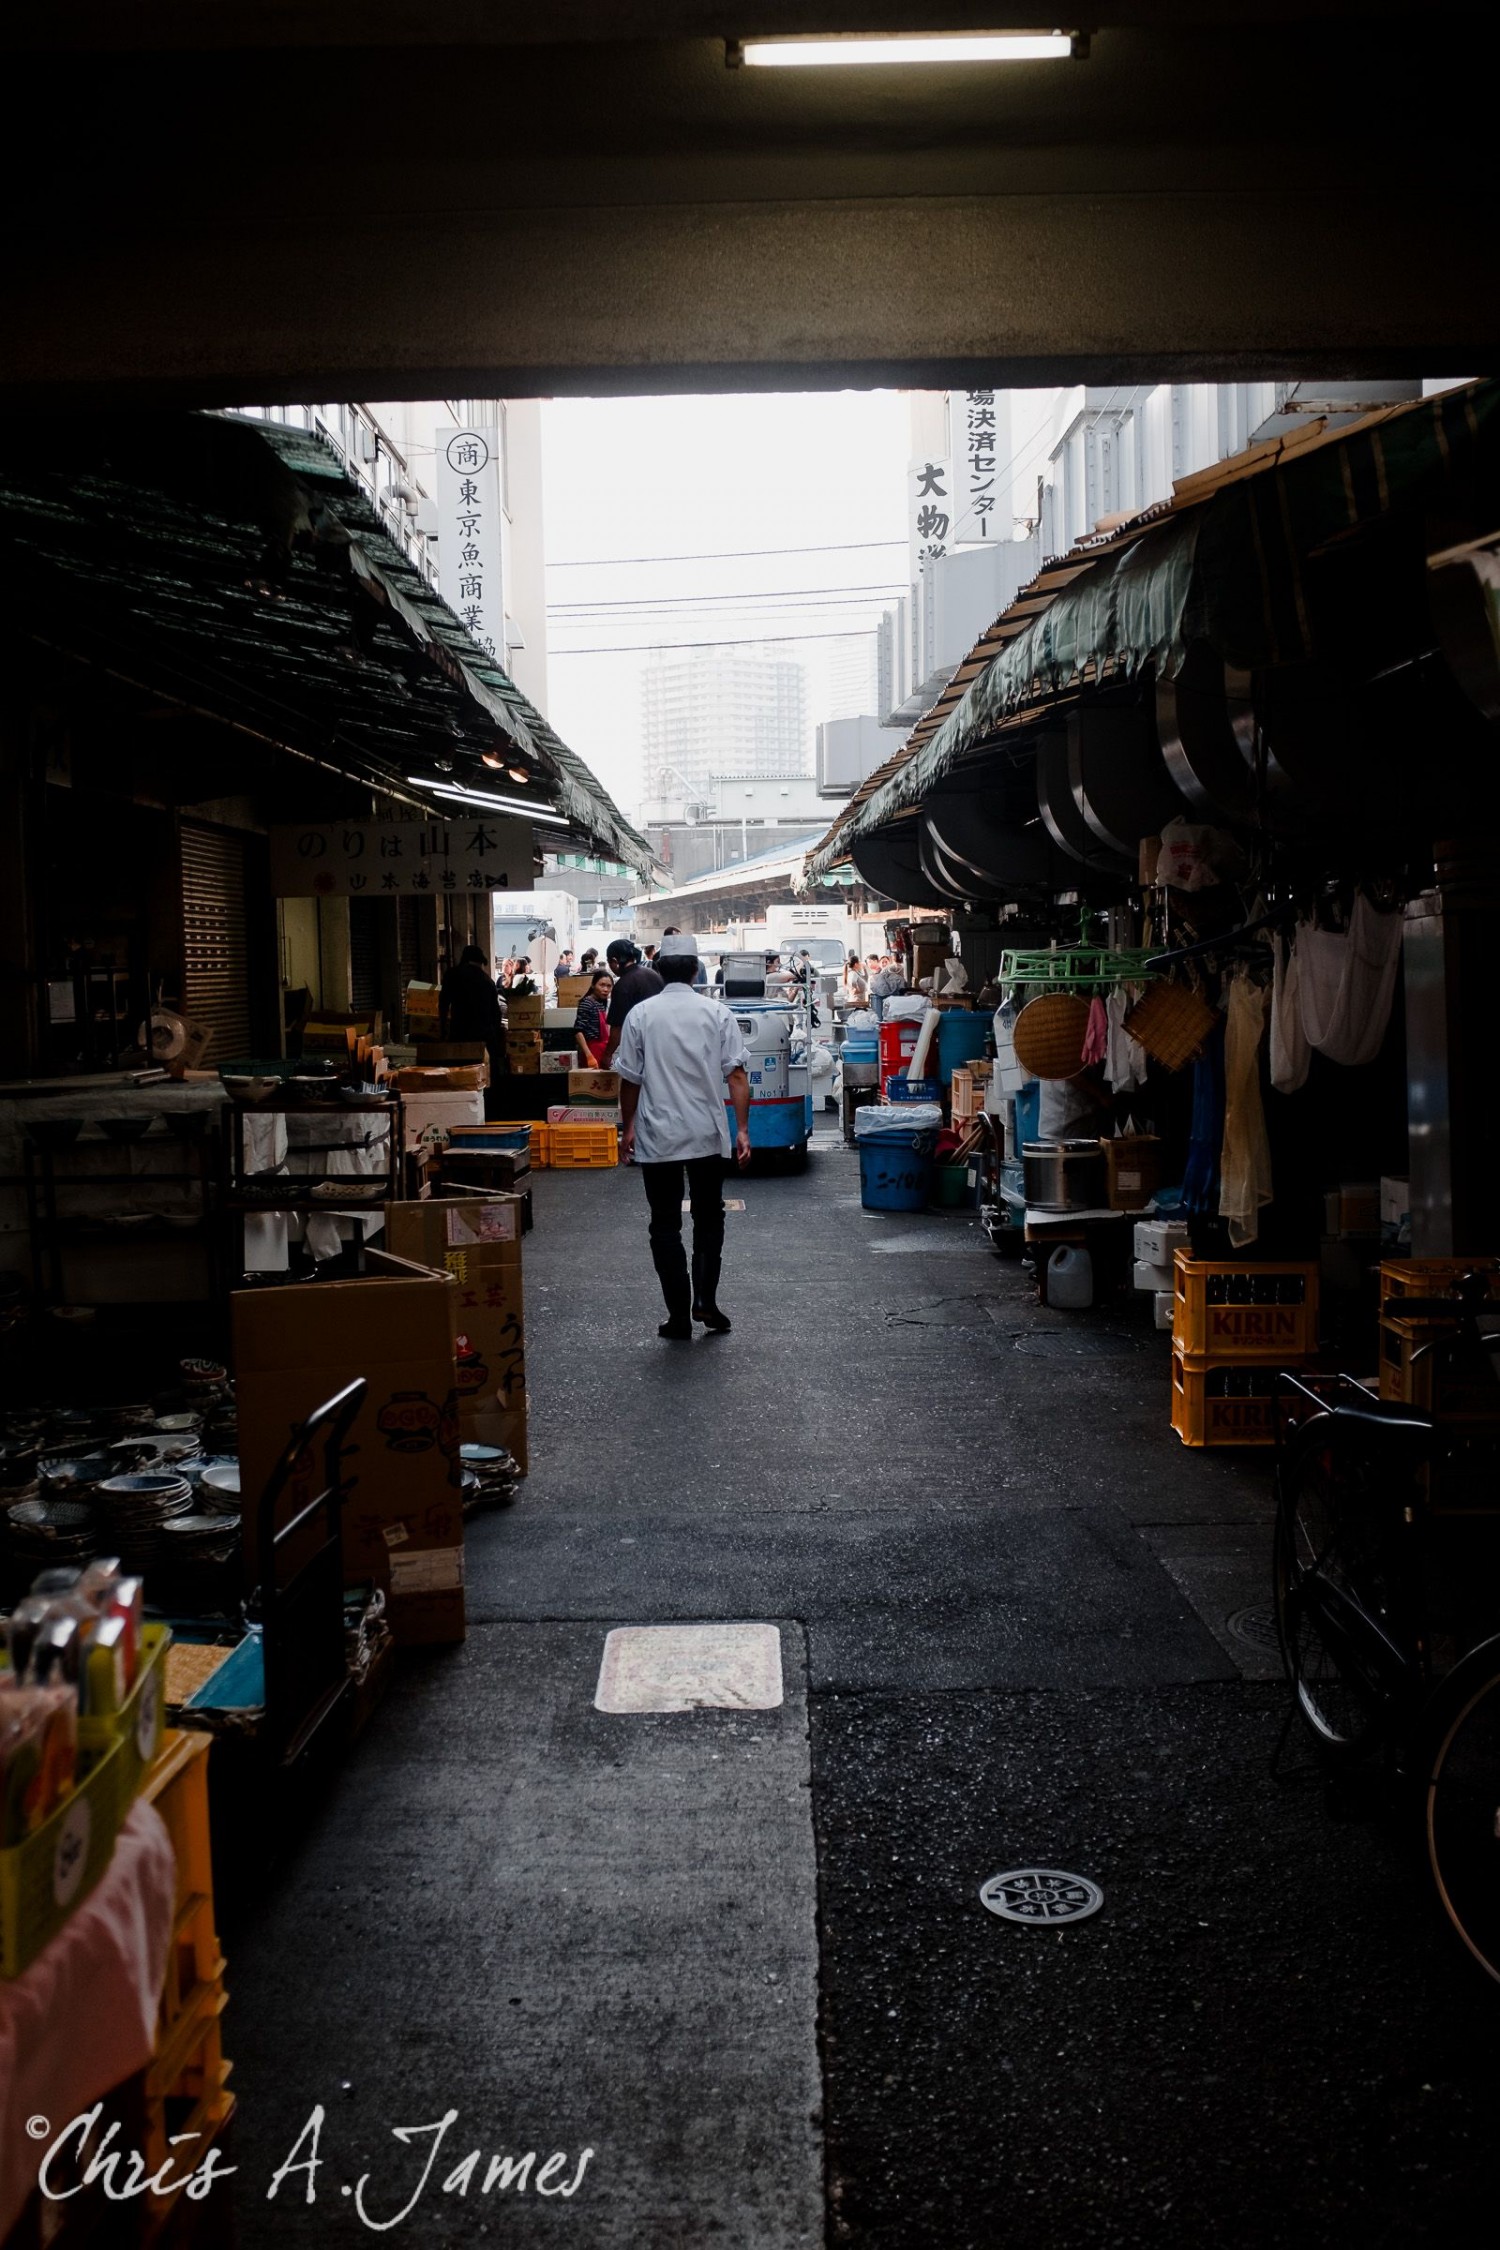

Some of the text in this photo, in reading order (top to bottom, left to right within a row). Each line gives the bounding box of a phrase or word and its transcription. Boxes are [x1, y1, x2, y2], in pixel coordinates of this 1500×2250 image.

[296, 824, 498, 859] のりは山本
[348, 869, 483, 890] 山本海苔店
[1213, 1311, 1296, 1335] KIRIN
[498, 1313, 526, 1395] うつわ
